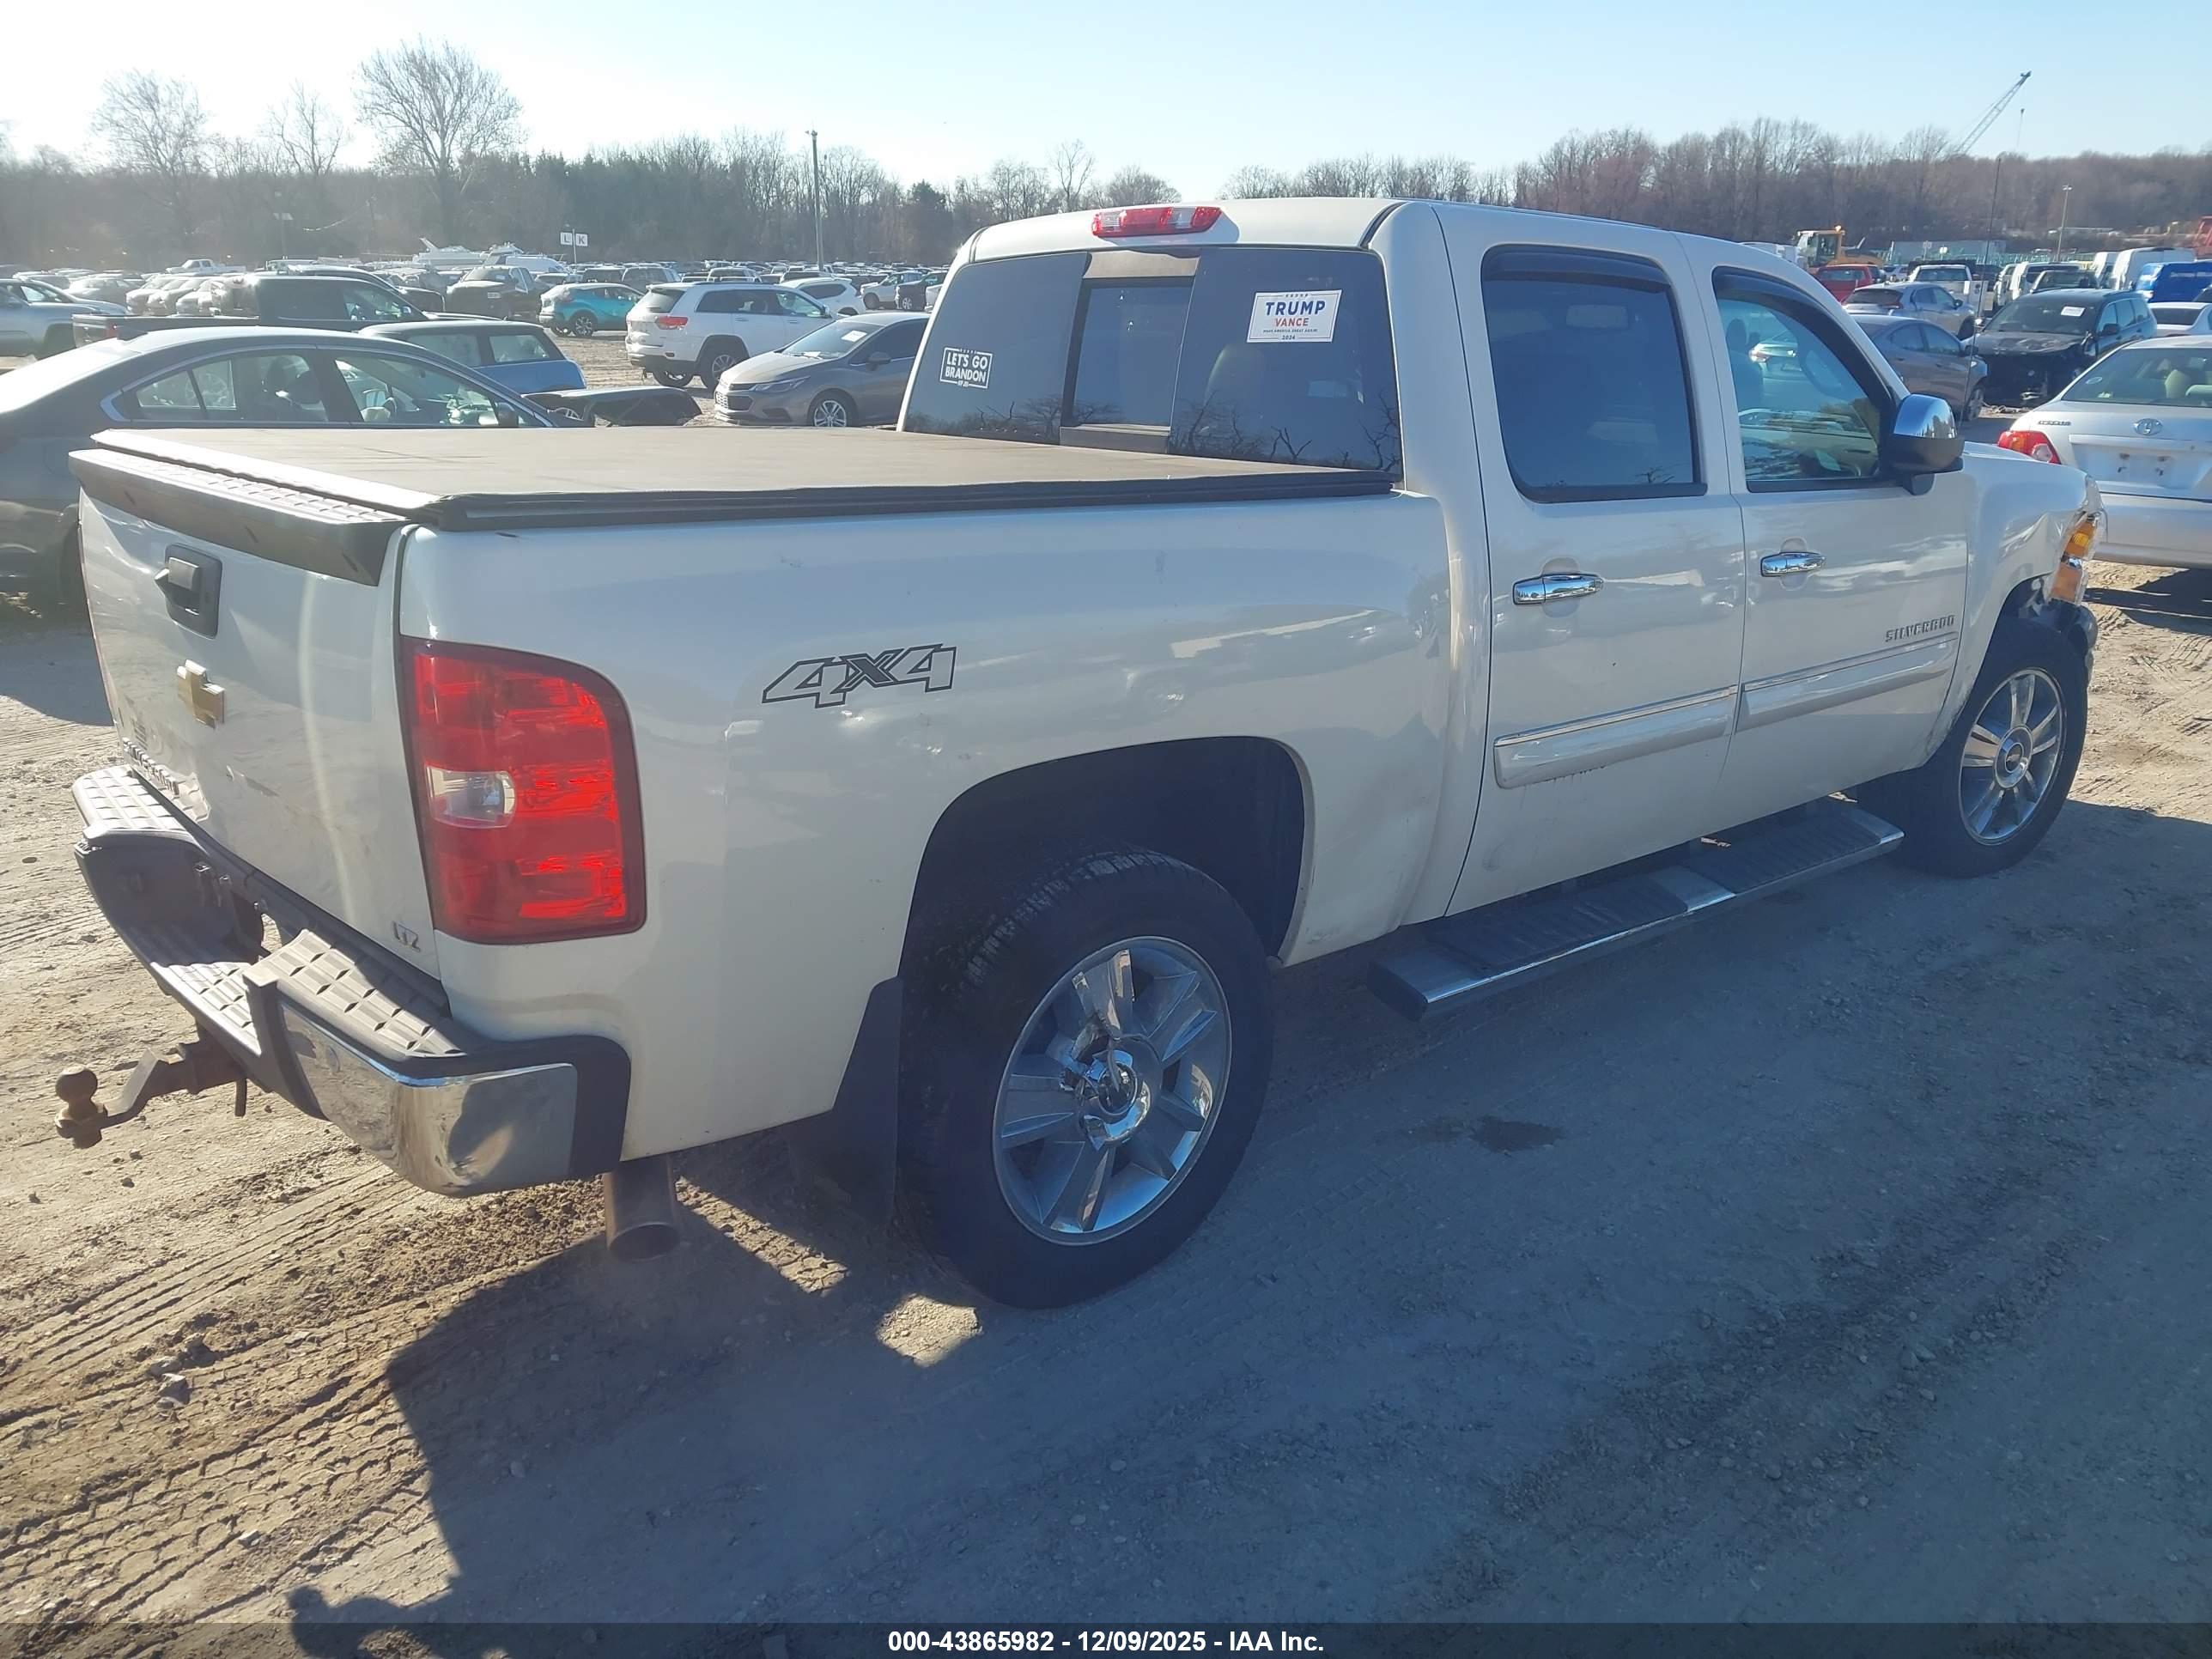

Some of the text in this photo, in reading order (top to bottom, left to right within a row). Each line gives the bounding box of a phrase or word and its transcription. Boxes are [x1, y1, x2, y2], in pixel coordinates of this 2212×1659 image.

[564, 234, 570, 243] L
[578, 235, 585, 245] K
[1266, 301, 1325, 315] TRUMP
[1275, 318, 1310, 326] VANCE
[946, 352, 988, 369] LET'S GO
[945, 366, 987, 383] BRANDON
[1885, 614, 1955, 642] SILVERADO
[392, 921, 422, 953] LTZ
